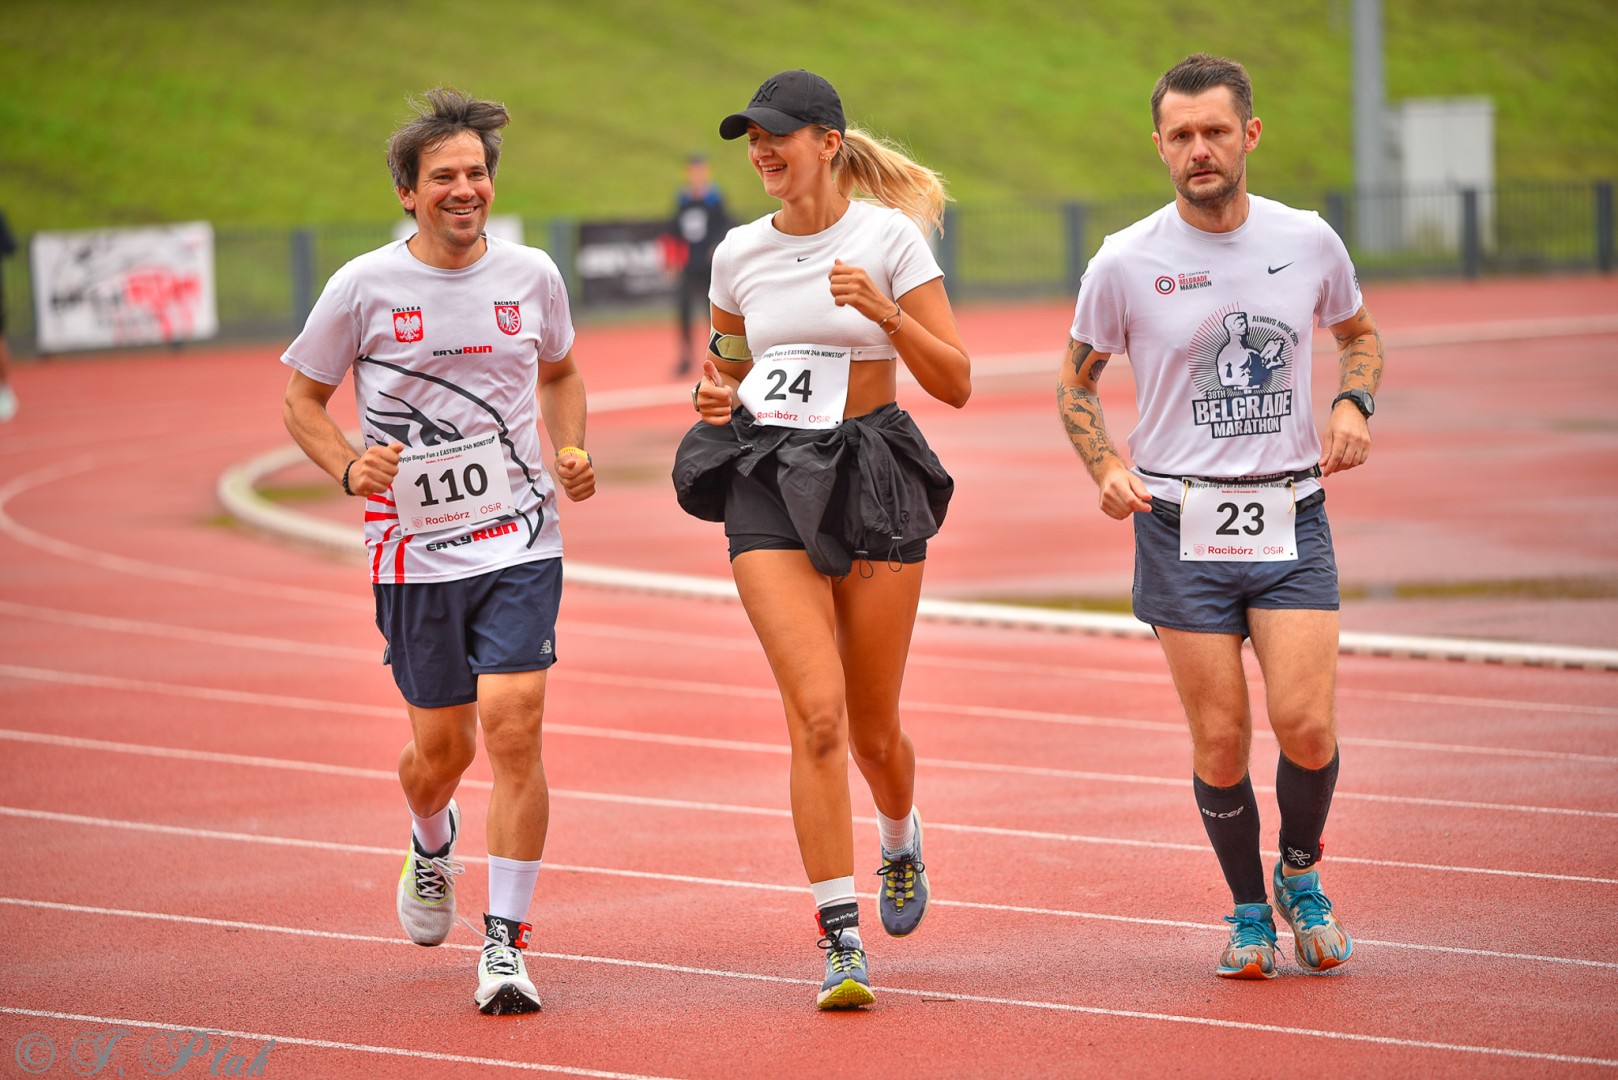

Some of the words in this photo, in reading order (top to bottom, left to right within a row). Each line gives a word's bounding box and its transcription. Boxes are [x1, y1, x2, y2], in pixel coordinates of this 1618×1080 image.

[1178, 275, 1208, 285] BELGRADE
[1180, 280, 1212, 291] MARATHON
[1252, 315, 1277, 326] ALWAYS
[1277, 320, 1293, 334] MORE
[764, 369, 812, 403] 24
[1207, 390, 1227, 400] 38TH
[757, 410, 798, 422] Racibórz
[1194, 391, 1292, 425] BELGRADE
[1213, 416, 1280, 437] MARATHON
[440, 446, 463, 457] EASYRUN
[463, 443, 473, 452] 24h
[414, 463, 488, 507] 110
[425, 511, 470, 525] Racibórz
[480, 502, 502, 514] OSiR
[1216, 502, 1265, 536] 23
[1207, 545, 1254, 555] Racibórz
[1263, 546, 1284, 555] OSiR
